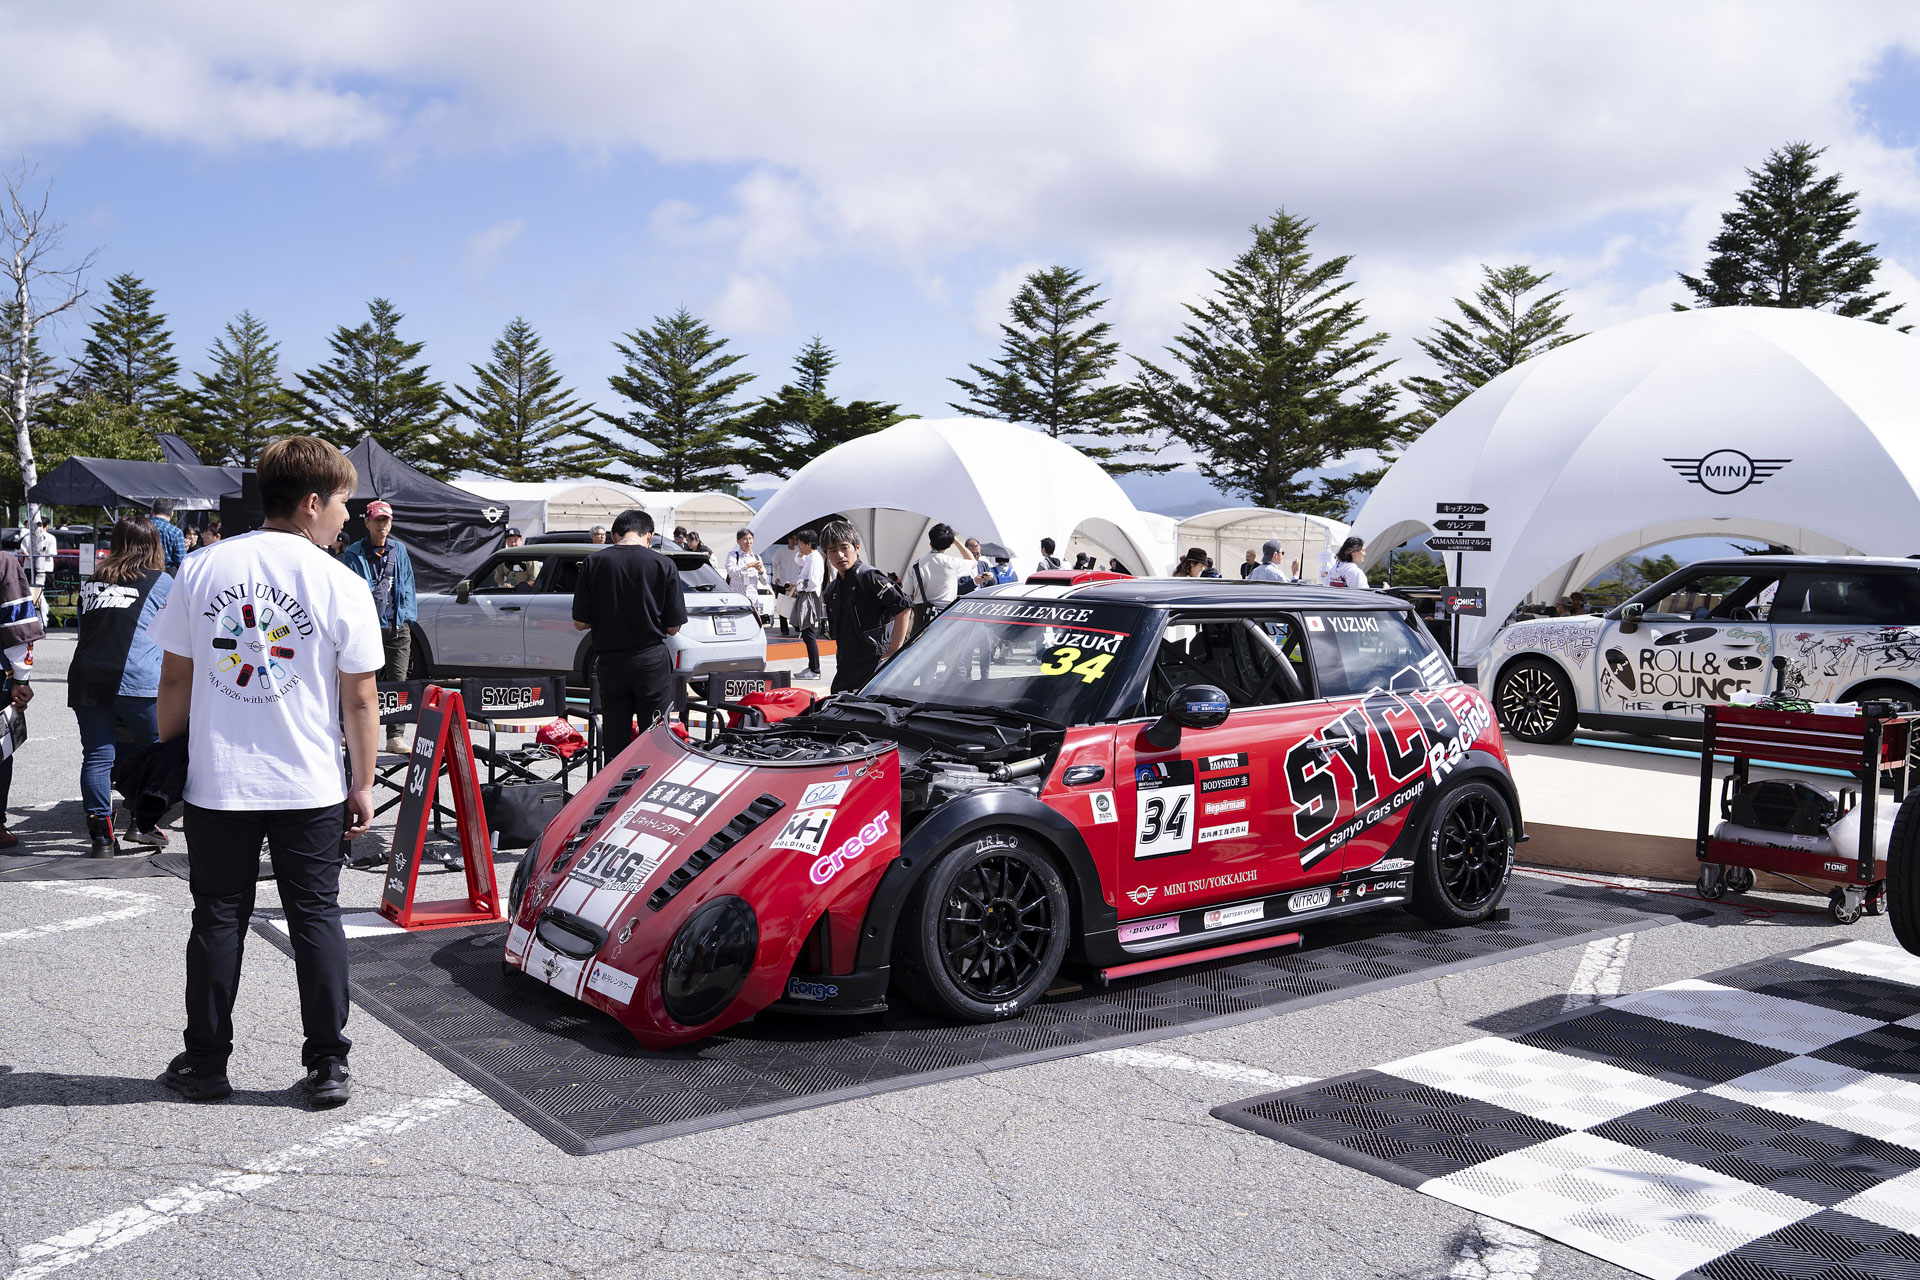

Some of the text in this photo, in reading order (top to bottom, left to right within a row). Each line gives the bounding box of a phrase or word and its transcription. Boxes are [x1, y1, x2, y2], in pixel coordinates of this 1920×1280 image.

[1705, 465, 1747, 477] MINI
[1443, 505, 1483, 513] キッチンカー
[1432, 538, 1491, 546] YAMANASHIマルシェ
[203, 583, 248, 623] MINI
[951, 601, 1093, 623] MINI CHALLENGE
[1327, 617, 1380, 633] YUZUKI
[1541, 636, 1597, 657] PEOPLE
[1040, 647, 1115, 684] 34
[220, 682, 241, 700] 2026
[243, 695, 263, 704] with
[265, 694, 281, 704] MIN
[280, 674, 302, 696] LIVE!
[482, 687, 532, 706] SYCG
[725, 680, 765, 696] SYCG
[384, 702, 412, 716] Racing
[518, 698, 544, 711] Racing
[1618, 695, 1655, 712] THE
[416, 736, 435, 758] SYCG
[1428, 695, 1491, 786] Racing
[410, 764, 427, 797] 34
[1203, 778, 1239, 790] BODYSHOP
[1205, 799, 1246, 815] Repairman
[1329, 780, 1425, 848] Sanyo Cars Group
[632, 815, 685, 836] Jネットレンタカー
[1140, 793, 1191, 844] 34
[773, 841, 817, 852] HOLDINGS
[809, 810, 890, 885] Creer
[576, 841, 645, 883] SYCG
[1381, 861, 1403, 870] WORKS
[1827, 863, 1847, 872] TONE
[602, 877, 645, 893] Racing
[1164, 869, 1258, 897] MINI TSU/YOKKAICHI
[1292, 892, 1326, 909] NITRON
[1223, 907, 1262, 919] BATTERY EXPERT
[1132, 923, 1167, 934] DUNLOP
[789, 977, 838, 1001] Forge
